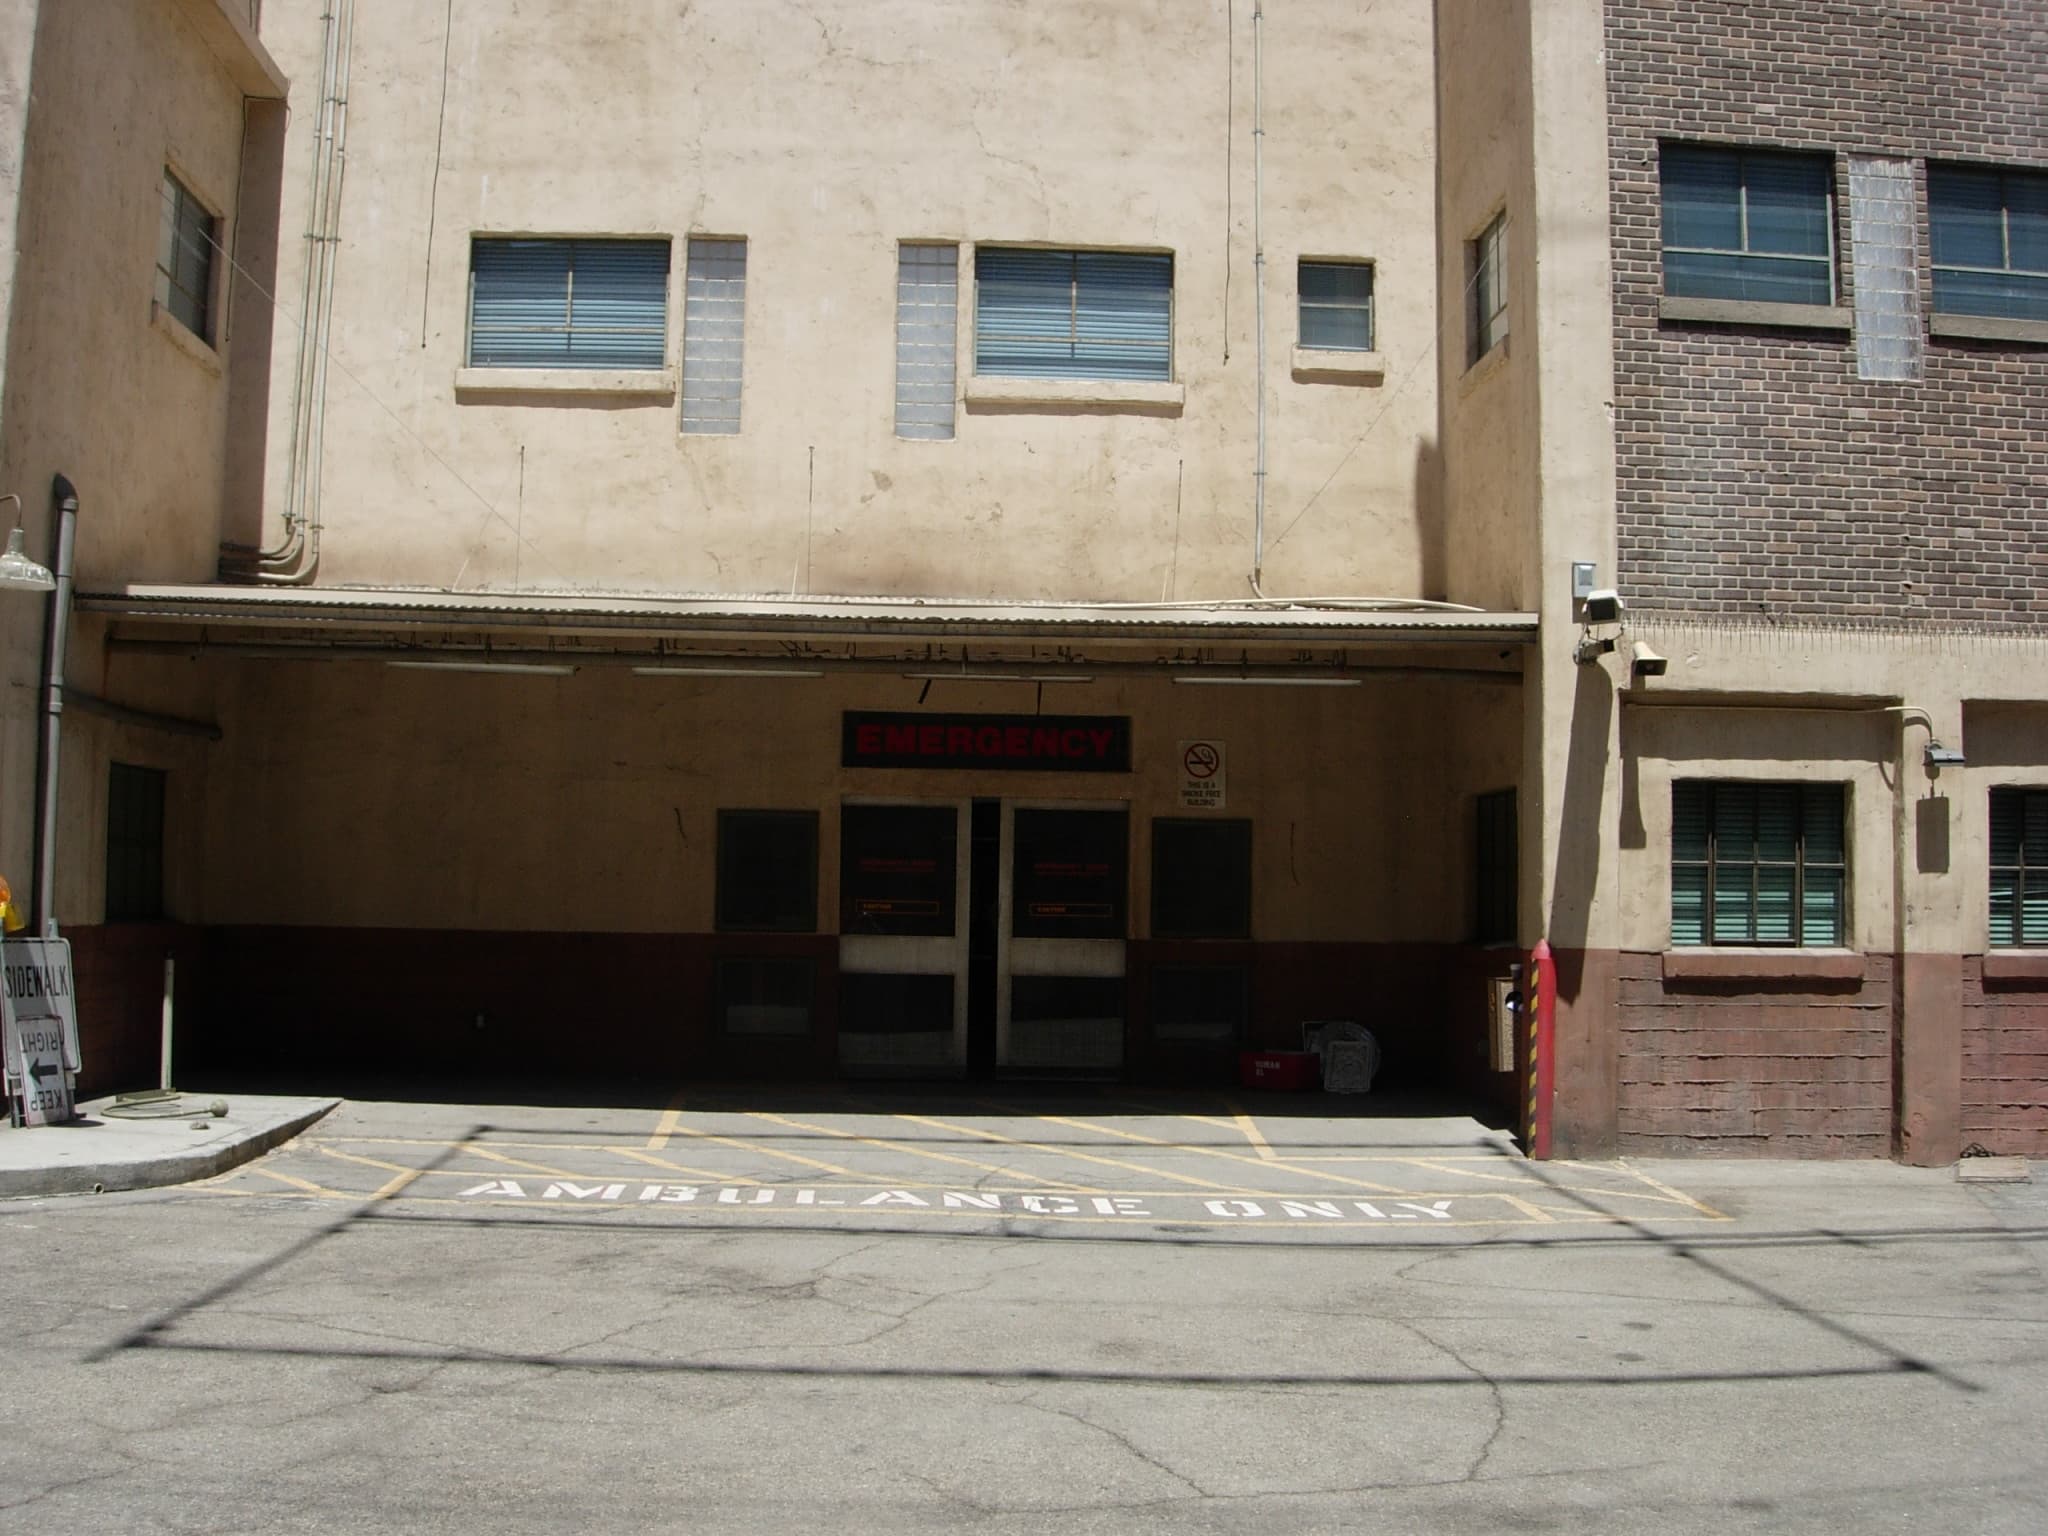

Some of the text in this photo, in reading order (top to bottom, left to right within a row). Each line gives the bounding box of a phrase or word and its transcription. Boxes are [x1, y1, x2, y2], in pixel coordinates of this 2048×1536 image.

[855, 723, 1113, 759] EMERGENCY
[5, 965, 69, 999] SIDEWALK
[22, 1031, 59, 1053] RIGHT
[30, 1089, 63, 1111] KEEP
[457, 1179, 1453, 1219] AMBULANCE ONLY
